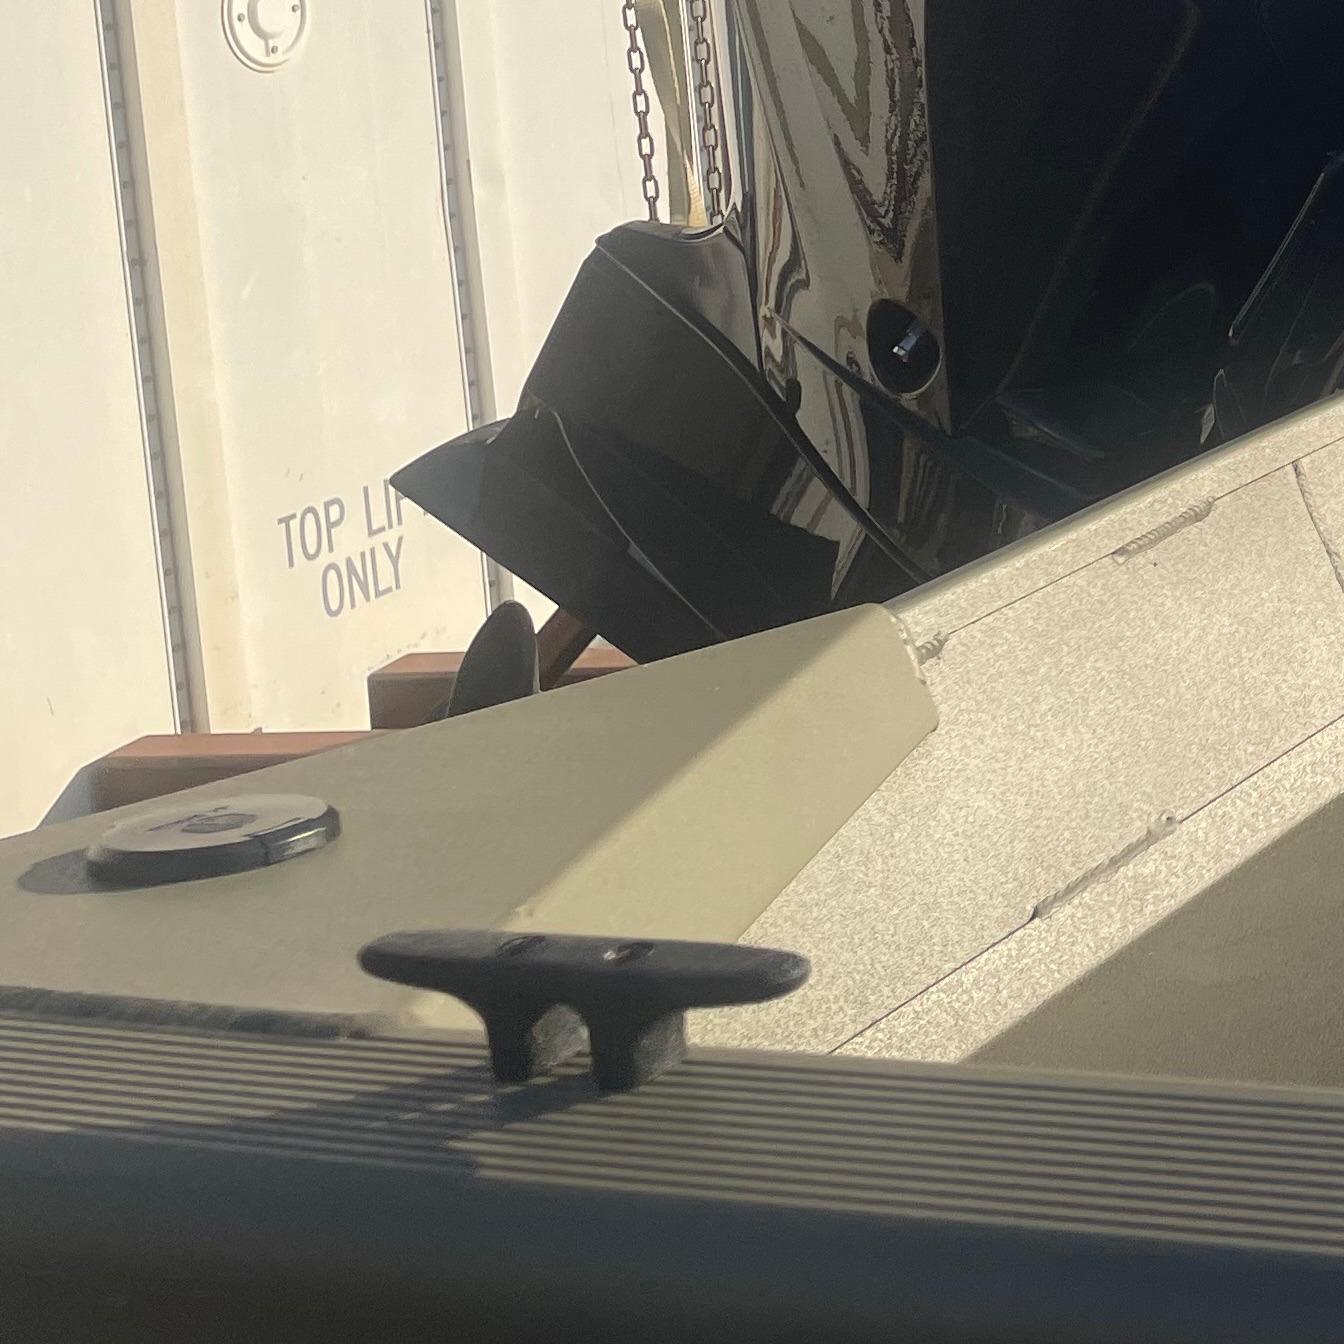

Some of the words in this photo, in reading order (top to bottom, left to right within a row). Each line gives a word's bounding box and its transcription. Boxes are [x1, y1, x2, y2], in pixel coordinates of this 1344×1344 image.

[277, 497, 346, 569] TOP
[363, 478, 428, 537] LIF
[321, 536, 404, 617] ONLY
